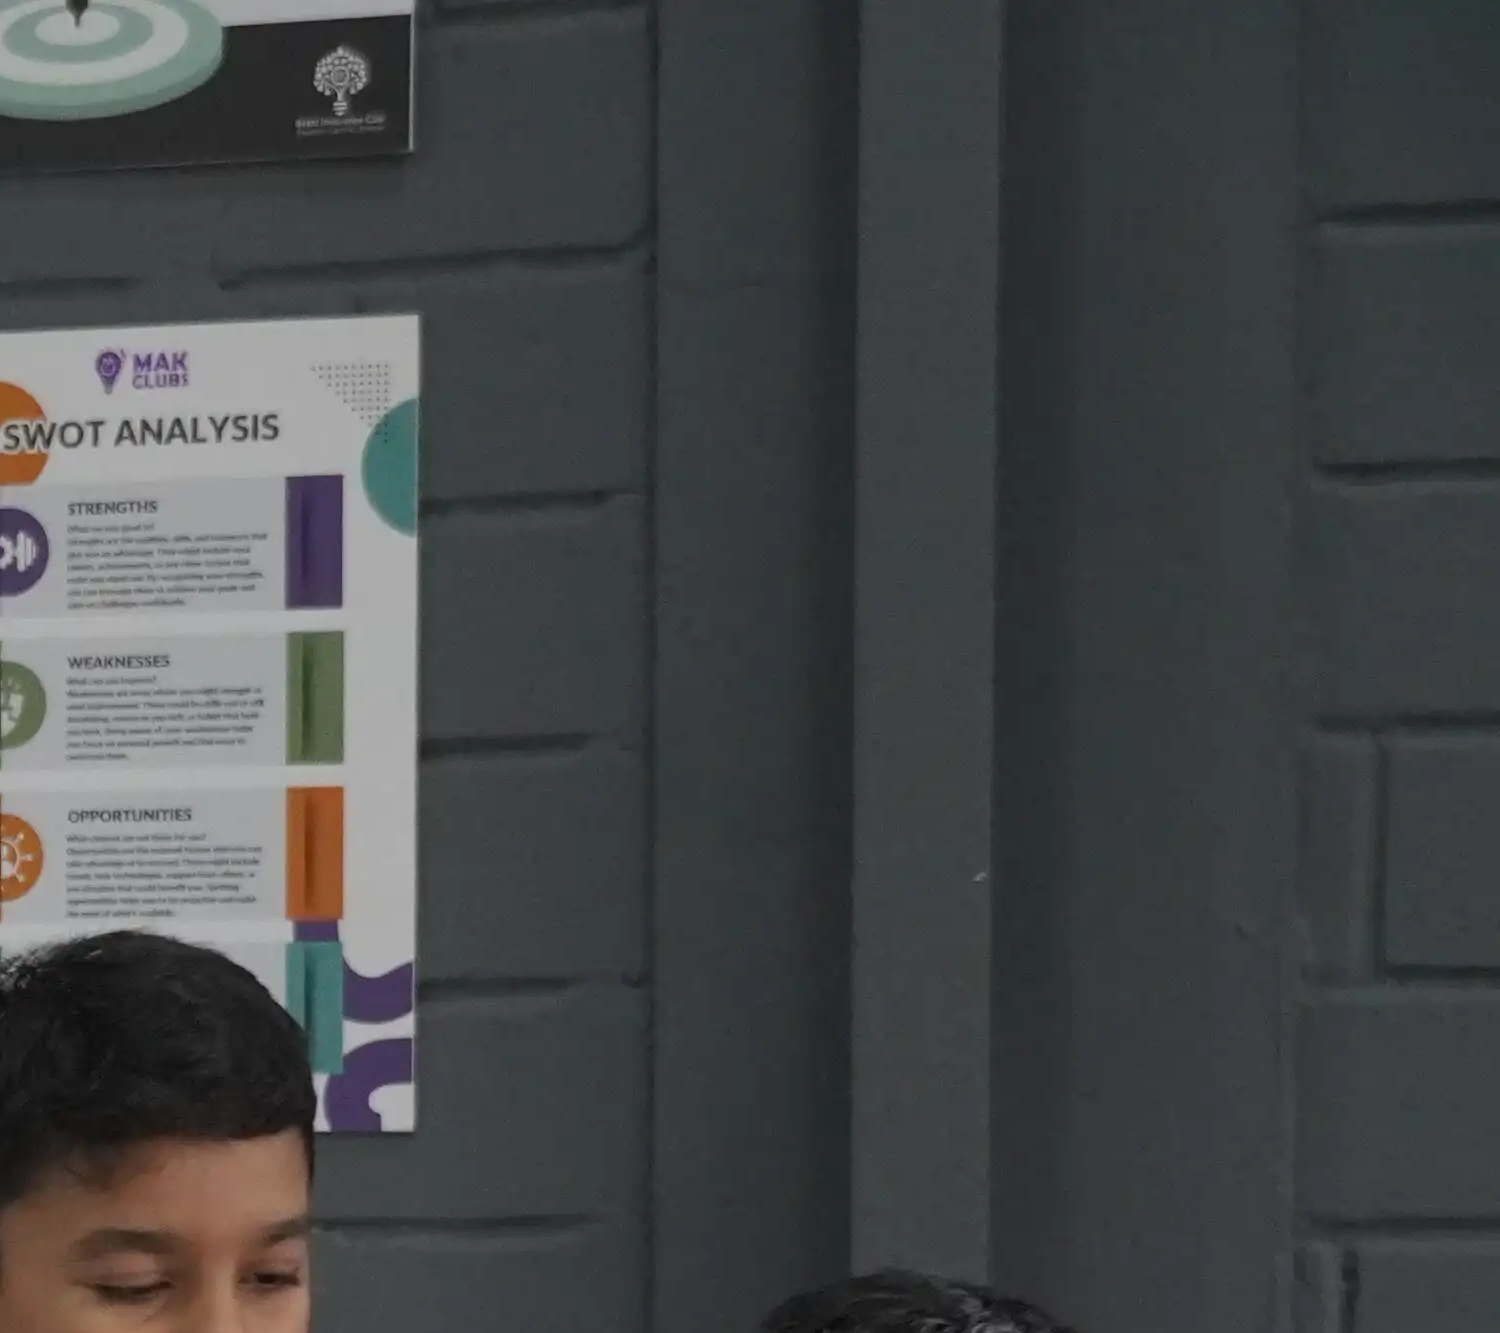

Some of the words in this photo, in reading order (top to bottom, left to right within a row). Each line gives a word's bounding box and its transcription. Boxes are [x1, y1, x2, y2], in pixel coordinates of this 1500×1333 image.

[132, 351, 188, 373] MAK
[131, 372, 189, 390] CLUBS
[2, 420, 104, 453] SWOT
[113, 414, 280, 447] ANALYSIS
[67, 499, 159, 516] STRENGTHS
[67, 654, 172, 670] WEAKNESSES
[67, 808, 193, 823] OPPORTUNITIES
